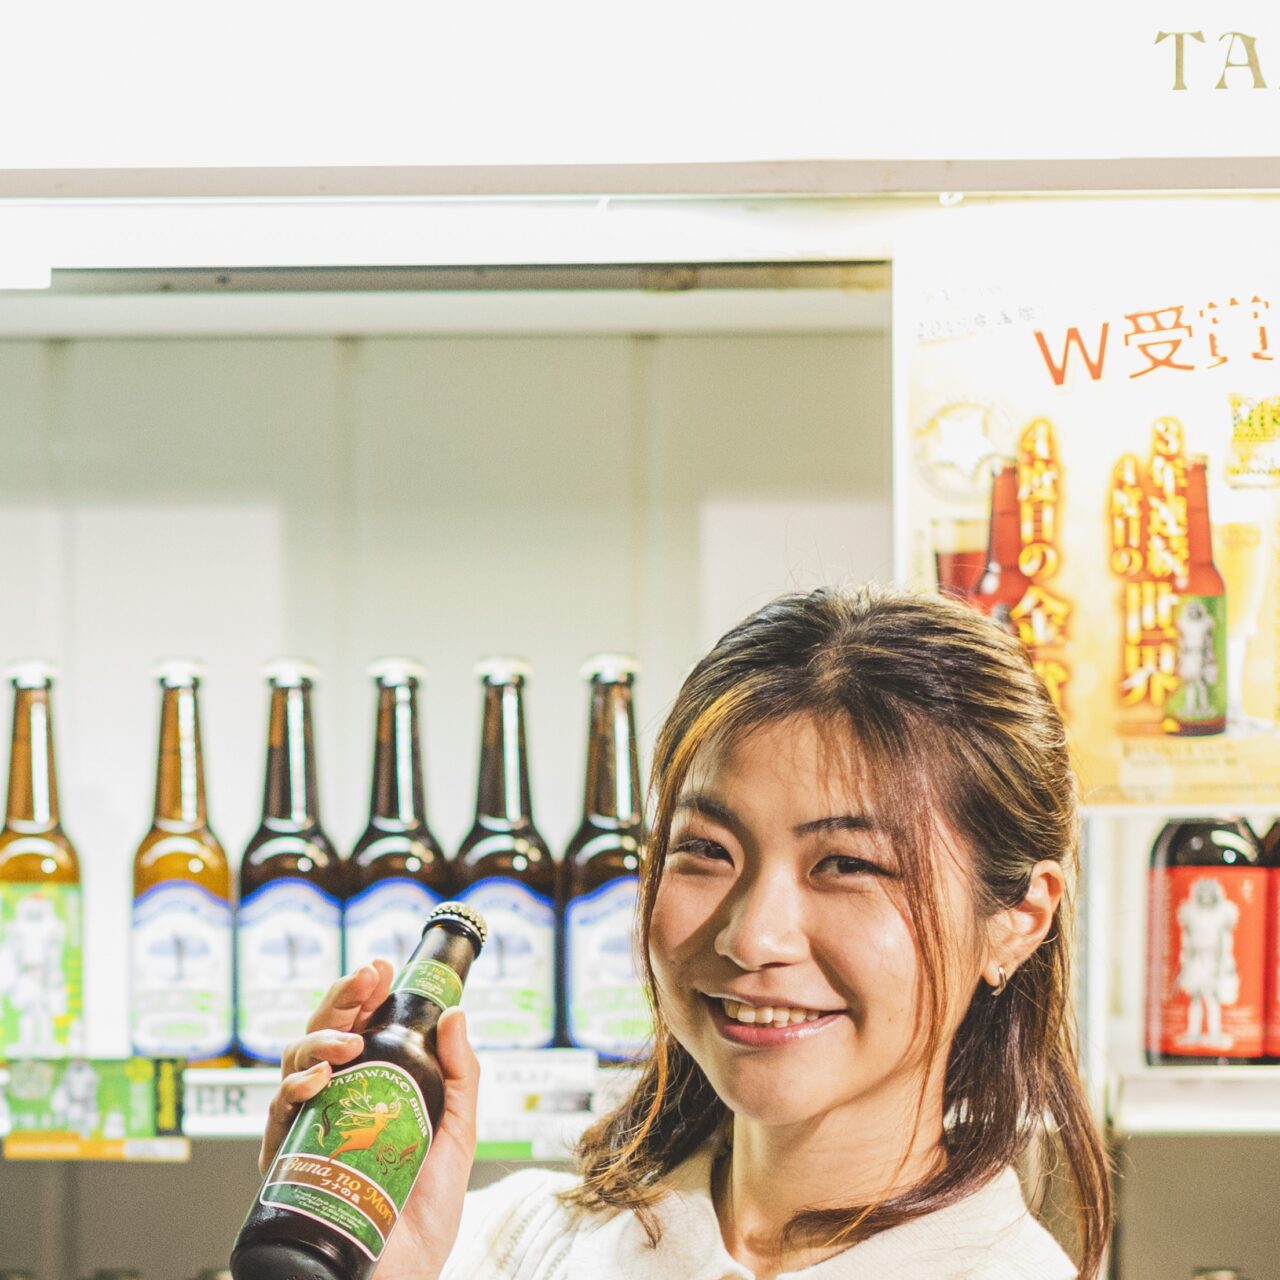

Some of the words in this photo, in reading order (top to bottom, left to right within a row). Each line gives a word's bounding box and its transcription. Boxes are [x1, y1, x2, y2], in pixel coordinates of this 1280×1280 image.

[1154, 29, 1280, 92] TA
[281, 1155, 332, 1179] Buna
[338, 1170, 362, 1193] no
